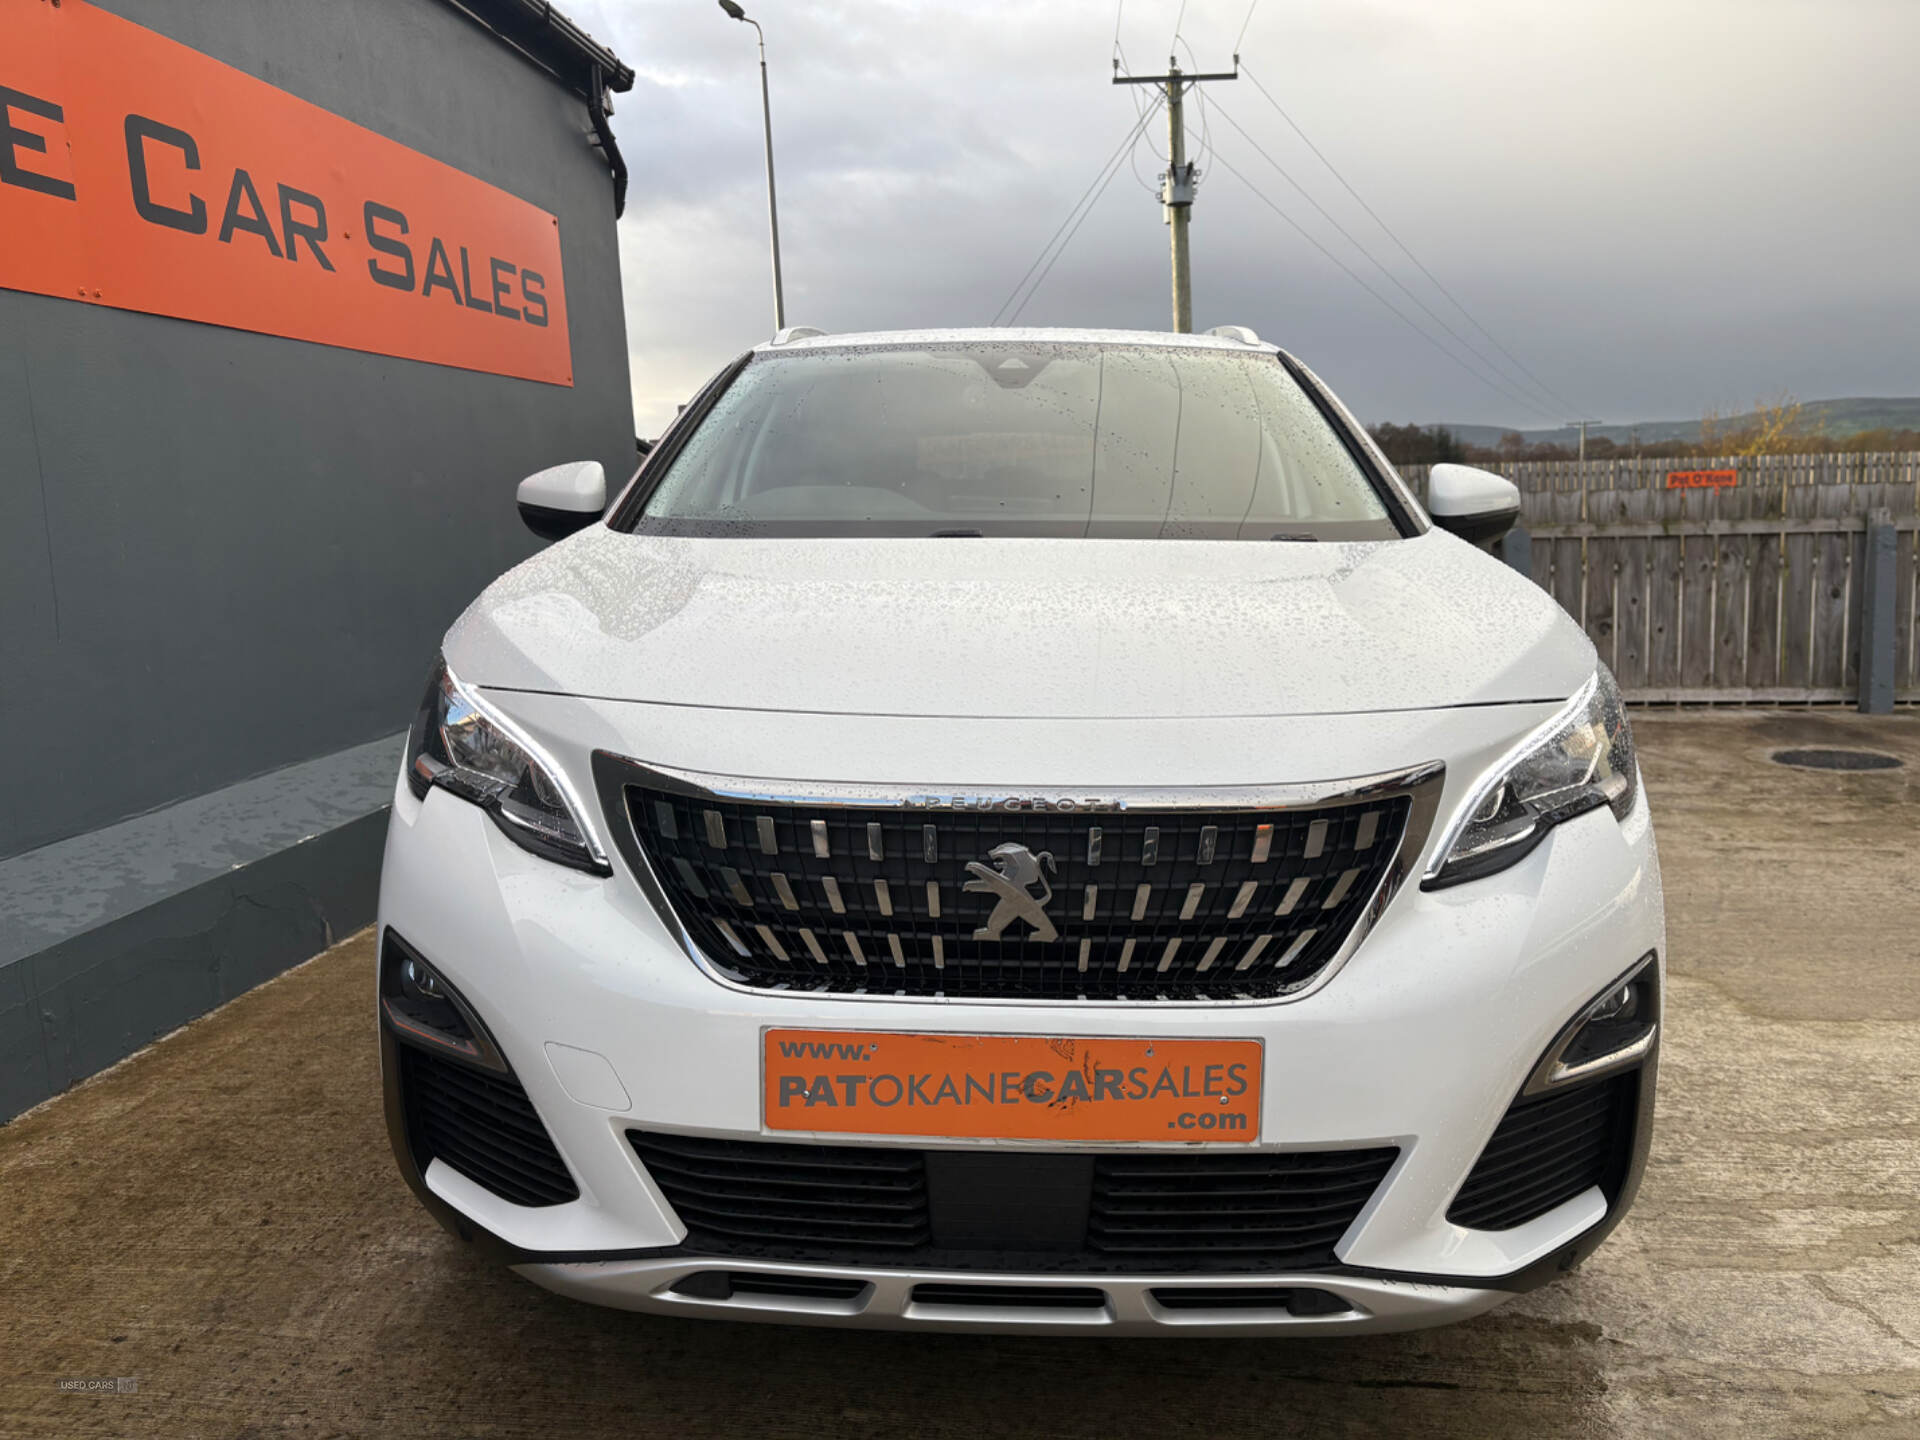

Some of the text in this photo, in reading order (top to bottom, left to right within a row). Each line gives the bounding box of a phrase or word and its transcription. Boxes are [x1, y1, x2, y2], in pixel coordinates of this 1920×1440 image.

[124, 113, 336, 273] CAR
[363, 200, 549, 328] SALES
[926, 797, 1101, 811] PEUGEOT
[779, 1041, 871, 1061] www.
[779, 1064, 1247, 1106] PATOKANECARSALES
[1168, 1111, 1248, 1131] .com
